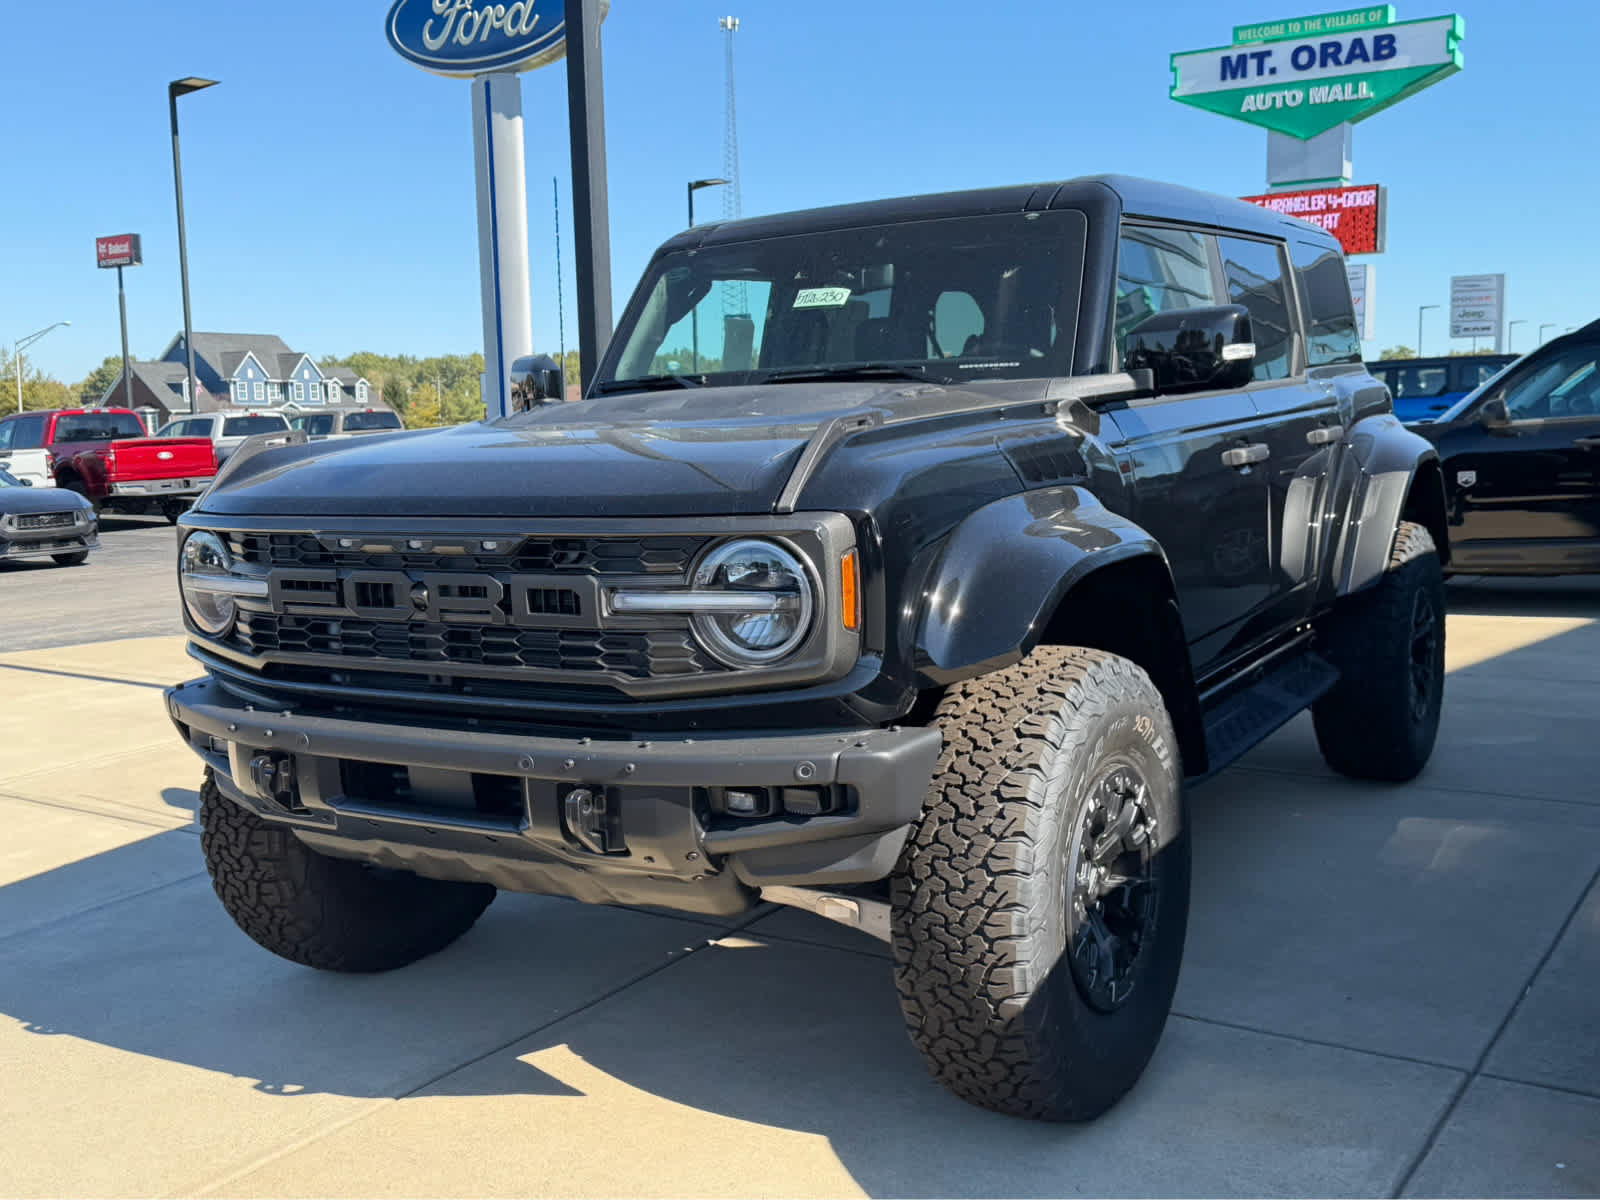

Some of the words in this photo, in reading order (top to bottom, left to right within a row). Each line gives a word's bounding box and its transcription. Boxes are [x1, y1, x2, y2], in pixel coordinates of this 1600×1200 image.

[421, 0, 540, 50] Ford
[1238, 25, 1285, 41] WELCOME
[1288, 22, 1301, 33] TO
[1304, 19, 1322, 31] THE
[1325, 13, 1366, 28] VILLAGE
[1369, 9, 1383, 22] OF
[1220, 50, 1277, 81] MT.
[1290, 33, 1398, 72] ORAB
[1240, 89, 1304, 112] AUTO
[1328, 190, 1377, 209] 4-DOOR
[1323, 212, 1341, 230] AT
[268, 567, 601, 630] FORD
